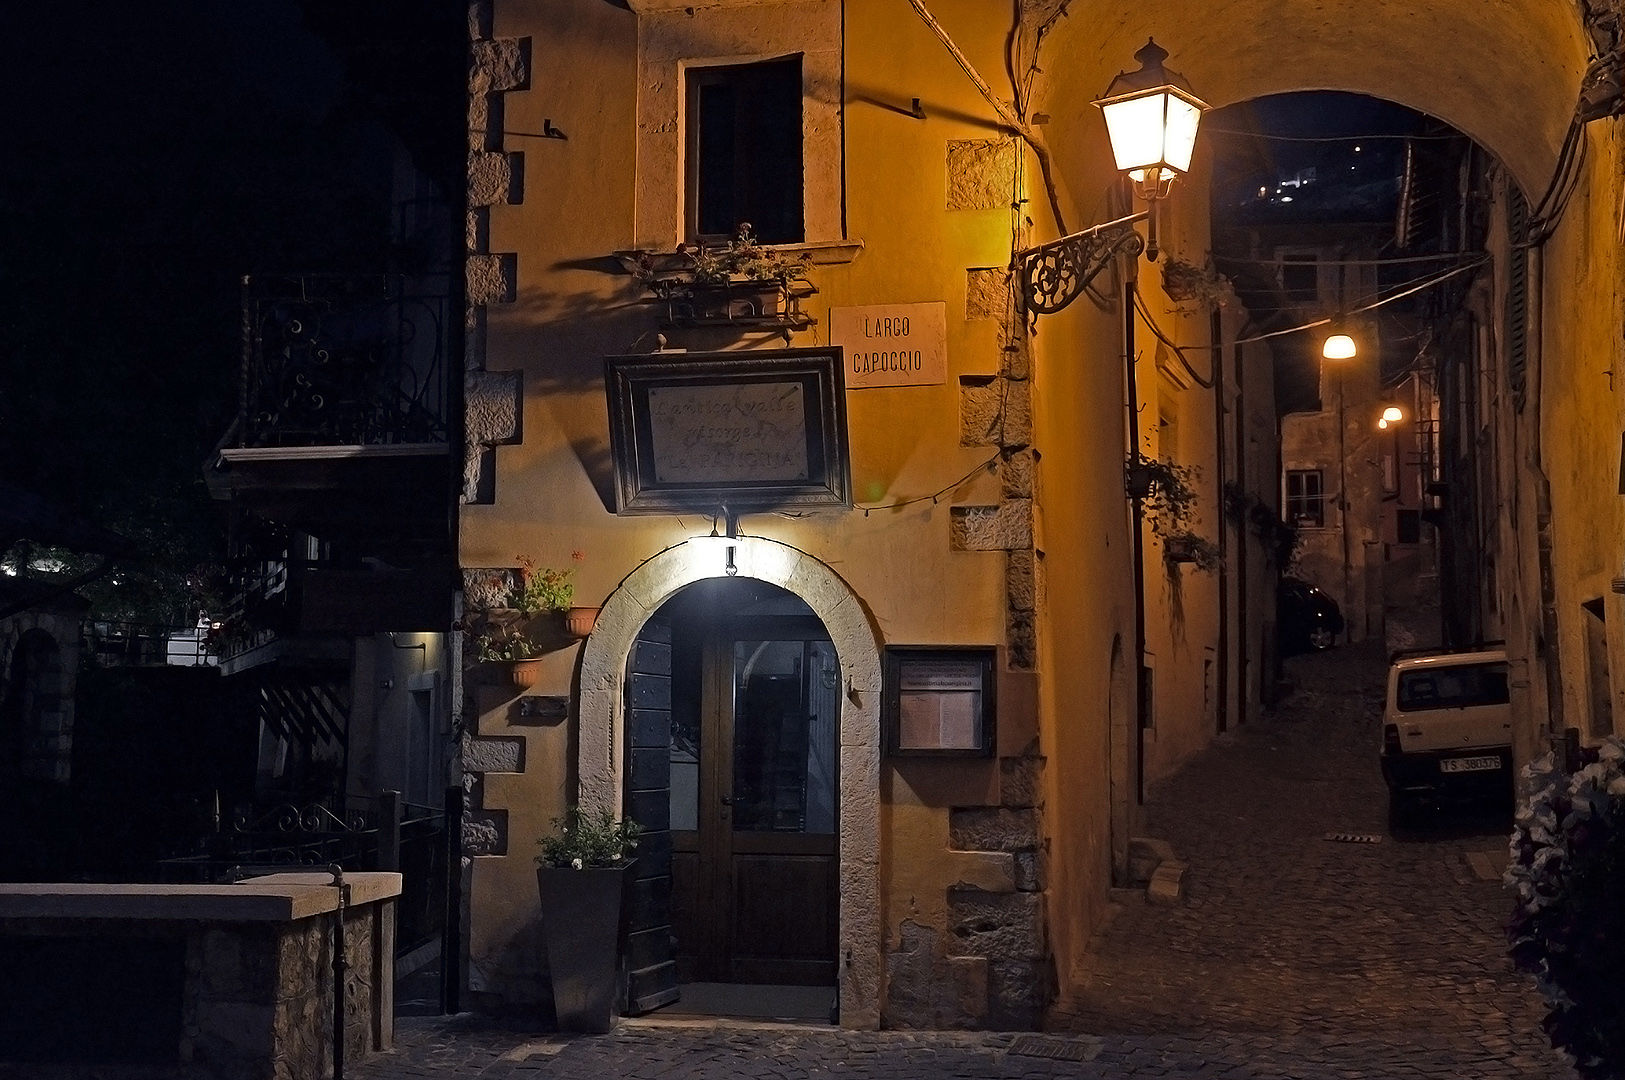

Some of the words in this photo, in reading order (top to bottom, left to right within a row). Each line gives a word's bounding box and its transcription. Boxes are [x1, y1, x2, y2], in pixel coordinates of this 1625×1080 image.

[865, 316, 910, 338] LARGO
[853, 350, 921, 374] CAPOCCIO
[1443, 760, 1457, 771] TS
